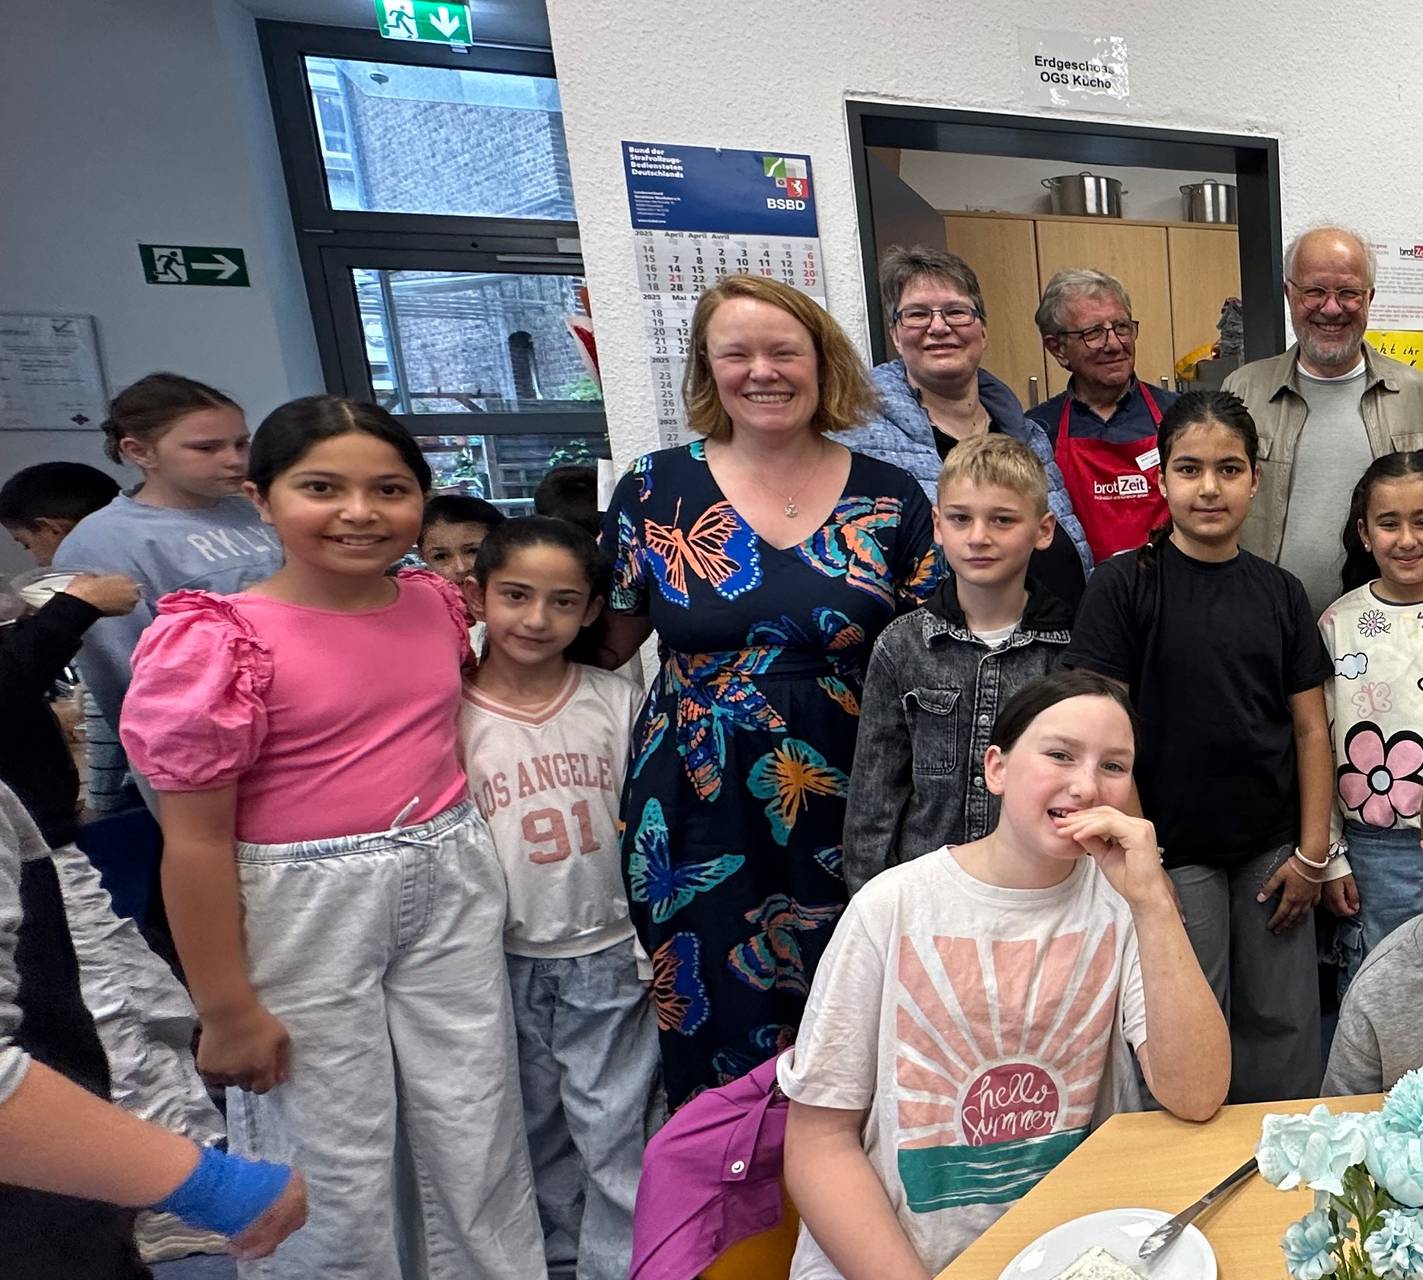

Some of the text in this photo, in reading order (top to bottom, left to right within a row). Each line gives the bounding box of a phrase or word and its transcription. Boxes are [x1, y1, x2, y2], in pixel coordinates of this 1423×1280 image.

[1040, 71, 1070, 85] OGS
[628, 146, 649, 154] Bund
[631, 168, 684, 179] Deutschlands
[767, 198, 806, 211] BSBD
[643, 245, 655, 253] 14
[718, 248, 725, 256] 2
[741, 249, 747, 257] 3
[785, 251, 792, 259] 5
[719, 257, 726, 265] 9
[736, 258, 749, 266] 10
[759, 259, 770, 267] 11
[781, 260, 793, 268] 12
[803, 261, 815, 269] 13
[645, 264, 657, 272] 16
[668, 265, 681, 273] 14
[691, 266, 704, 274] 15
[782, 269, 794, 277] 19
[692, 275, 705, 283] 22
[648, 283, 660, 291] 18
[670, 284, 684, 292] 28
[651, 309, 663, 317] 18
[681, 319, 688, 327] 5
[653, 328, 689, 336] 20 12
[655, 337, 666, 345] 21
[656, 346, 668, 354] 22
[659, 372, 671, 380] 23
[660, 381, 672, 389] 24
[661, 390, 673, 398] 25
[664, 408, 675, 416] 27
[667, 433, 679, 441] 27
[186, 526, 281, 562] RKLY
[475, 752, 613, 822] LOS ANGELE
[521, 800, 601, 865] 91
[971, 1071, 1057, 1122] hello
